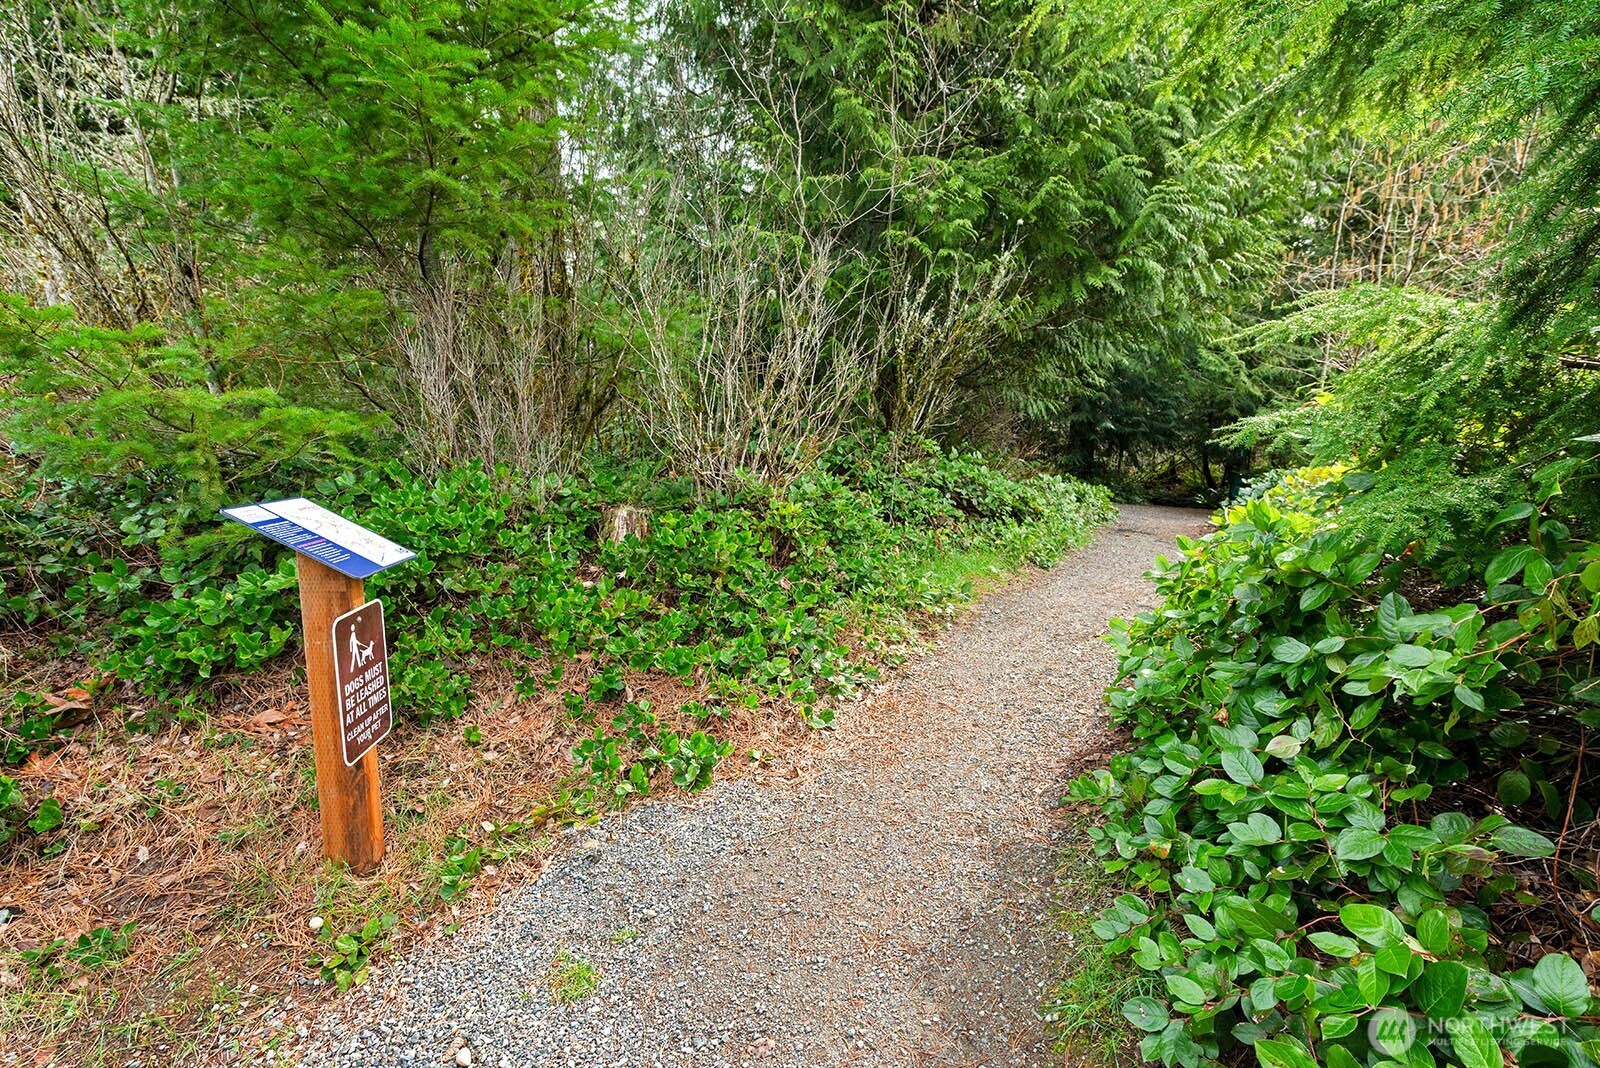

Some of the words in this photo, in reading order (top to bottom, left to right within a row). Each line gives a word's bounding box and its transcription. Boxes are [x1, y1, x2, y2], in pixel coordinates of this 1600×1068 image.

[344, 675, 364, 696] DOGS
[365, 662, 383, 682] MUST
[346, 695, 355, 712] BE
[356, 675, 384, 704] LEASHED
[346, 711, 354, 726] AT
[355, 702, 367, 718] ALL
[368, 687, 387, 708] TIMES
[347, 722, 364, 742] CLEAN
[365, 716, 372, 728] UP
[372, 704, 388, 722] AFTER
[357, 728, 371, 745] YOUR
[372, 719, 381, 733] PET
